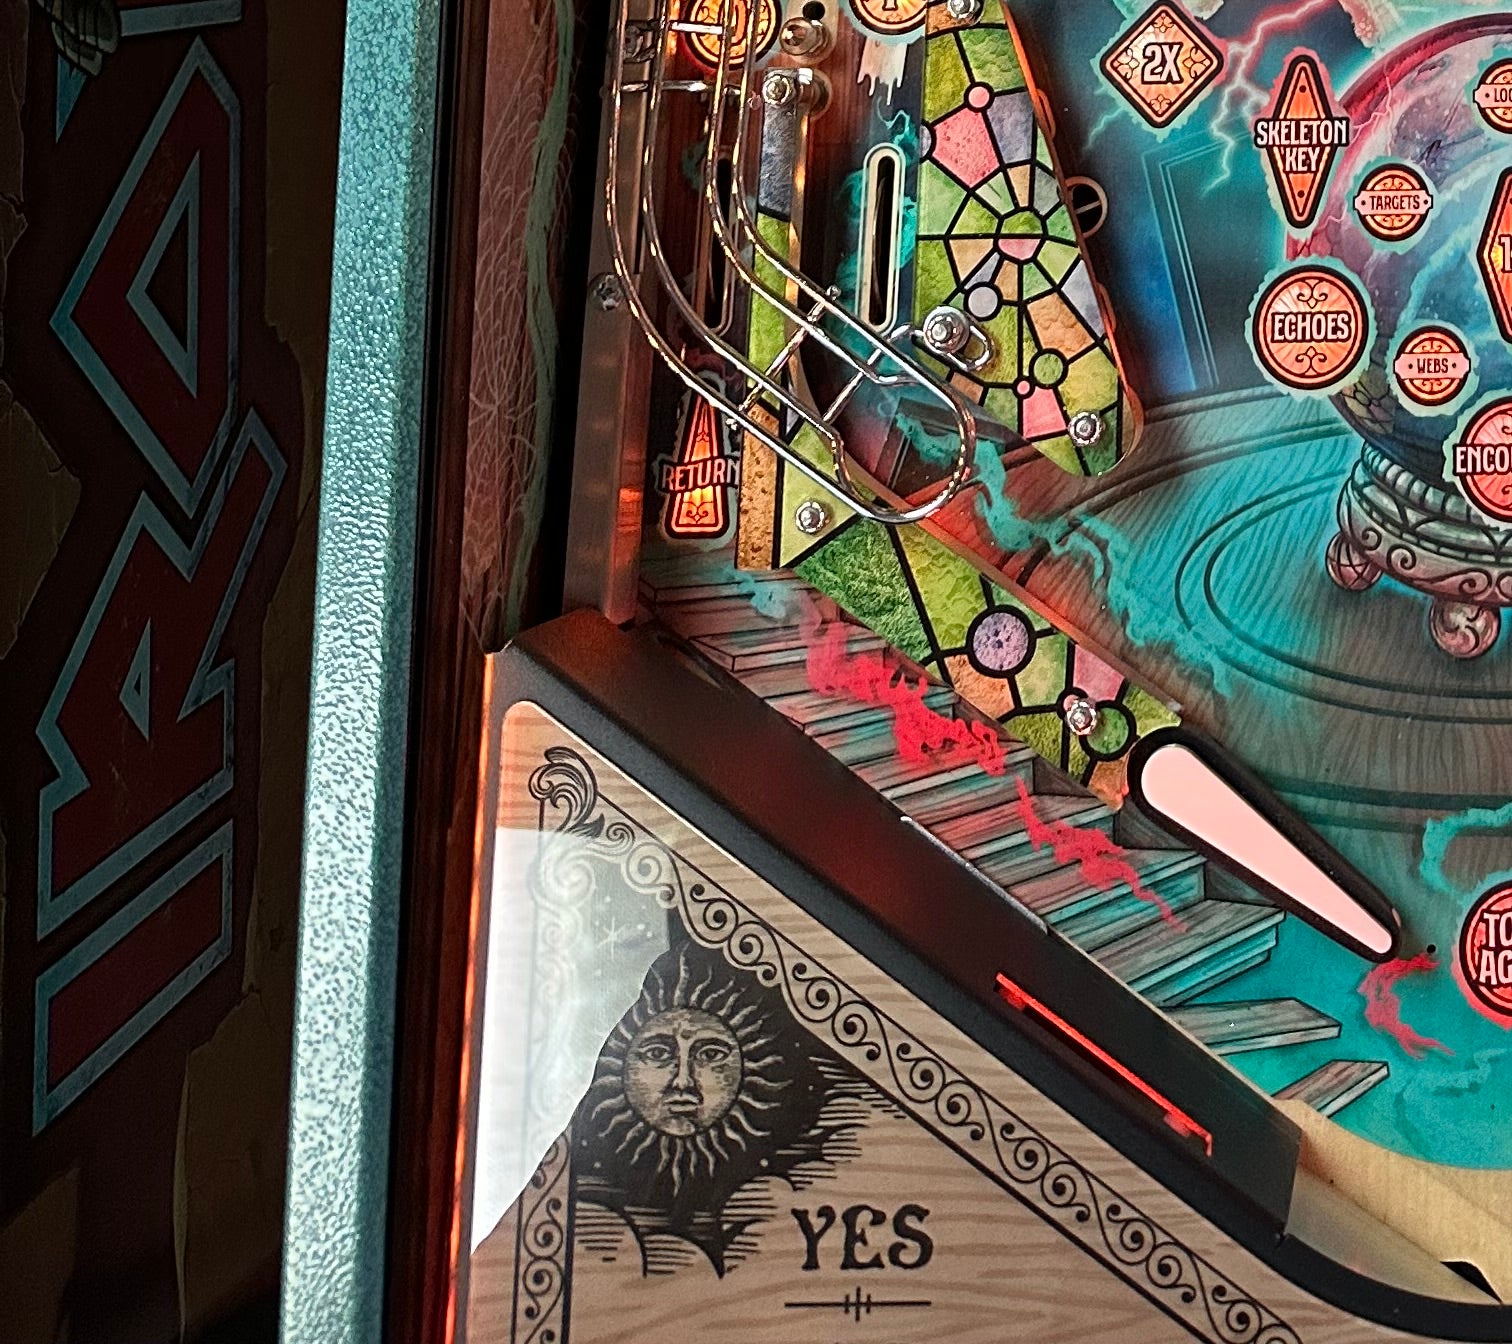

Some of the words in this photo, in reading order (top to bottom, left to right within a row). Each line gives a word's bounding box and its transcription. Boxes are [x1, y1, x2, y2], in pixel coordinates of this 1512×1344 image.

[1141, 43, 1182, 84] 2X
[1256, 120, 1348, 146] SKELETON
[1285, 147, 1320, 172] KEY
[1369, 194, 1420, 211] TARGETS
[1273, 314, 1350, 341] ECHOES
[1416, 357, 1449, 374] WEBS
[661, 458, 741, 492] RETURN
[790, 1203, 934, 1271] YES
